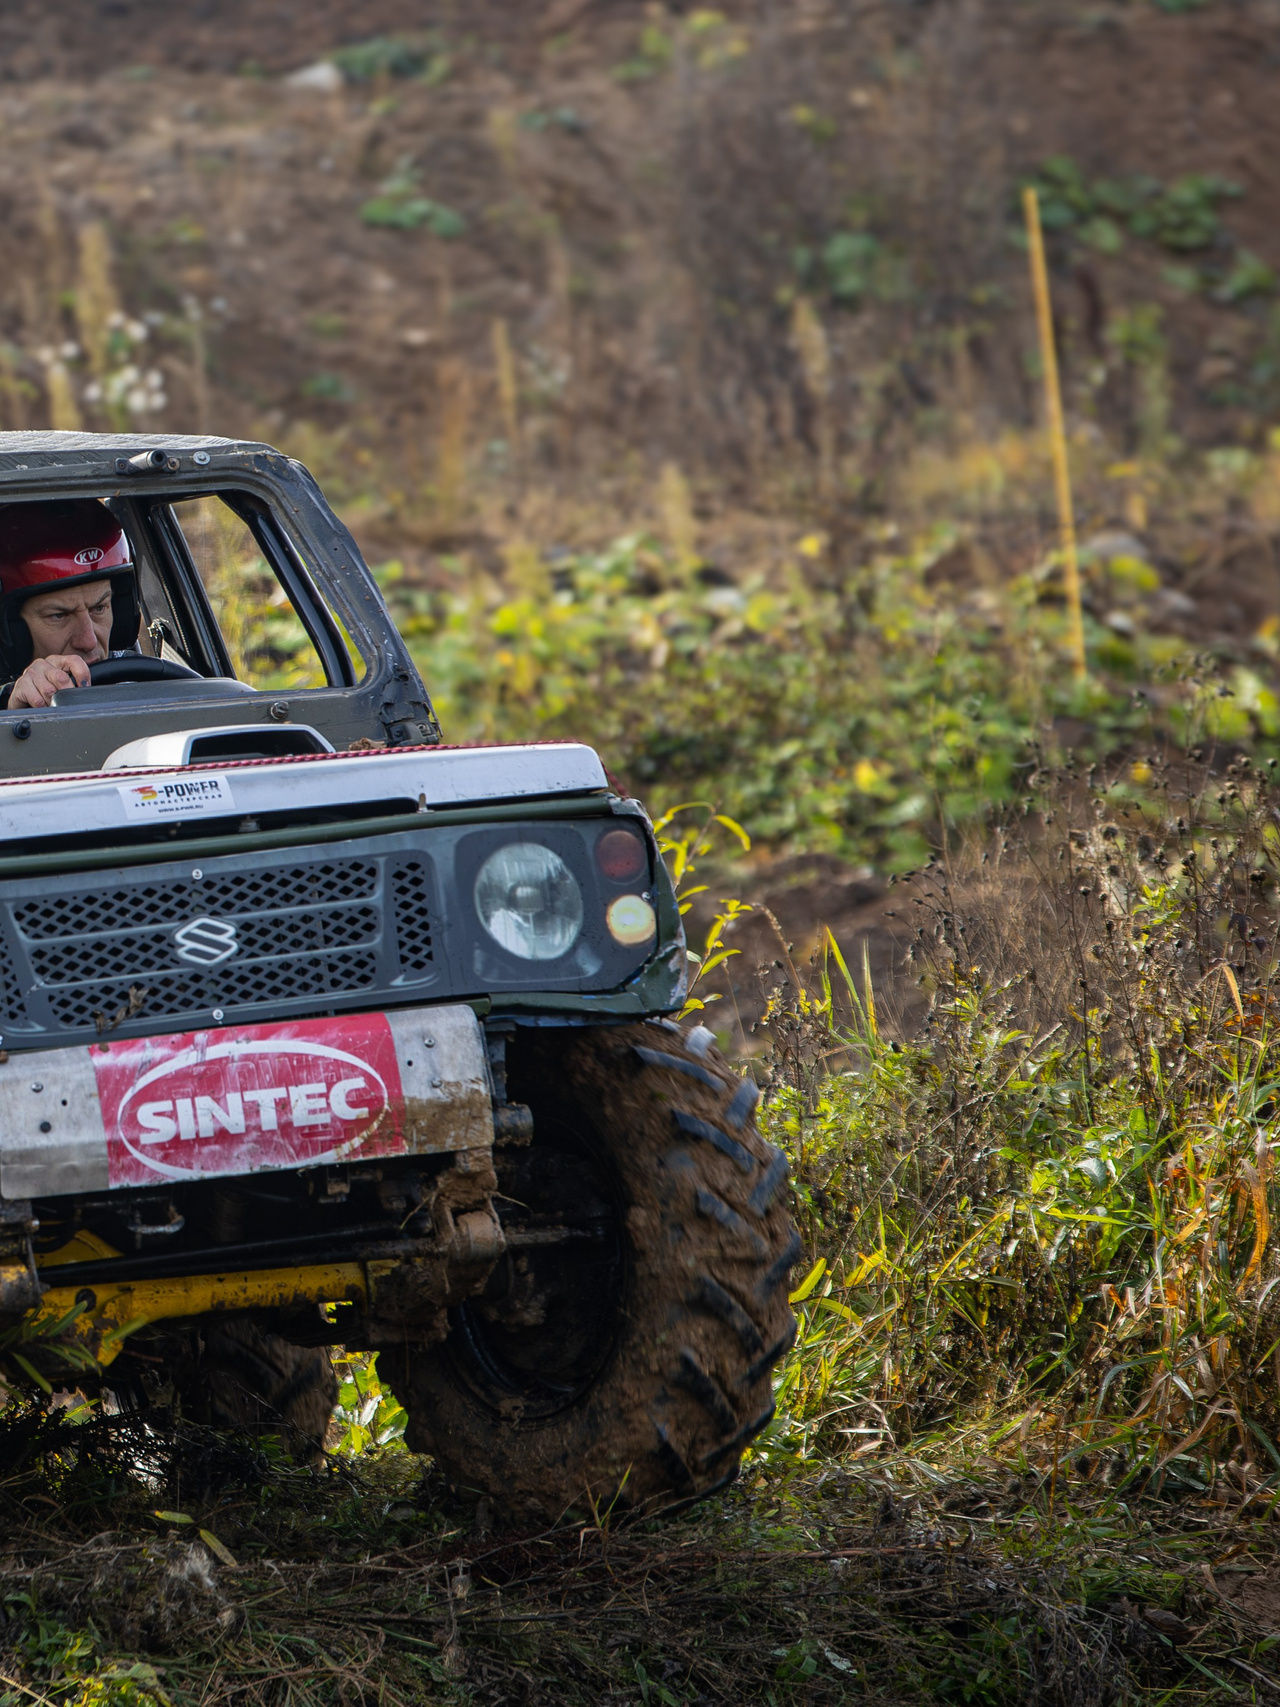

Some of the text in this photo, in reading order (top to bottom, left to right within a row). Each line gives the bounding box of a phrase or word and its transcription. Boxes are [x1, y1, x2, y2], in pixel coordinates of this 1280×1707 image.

[79, 549, 99, 563] KW
[131, 780, 221, 800] S-POWER
[136, 1076, 370, 1146] SINTEC
